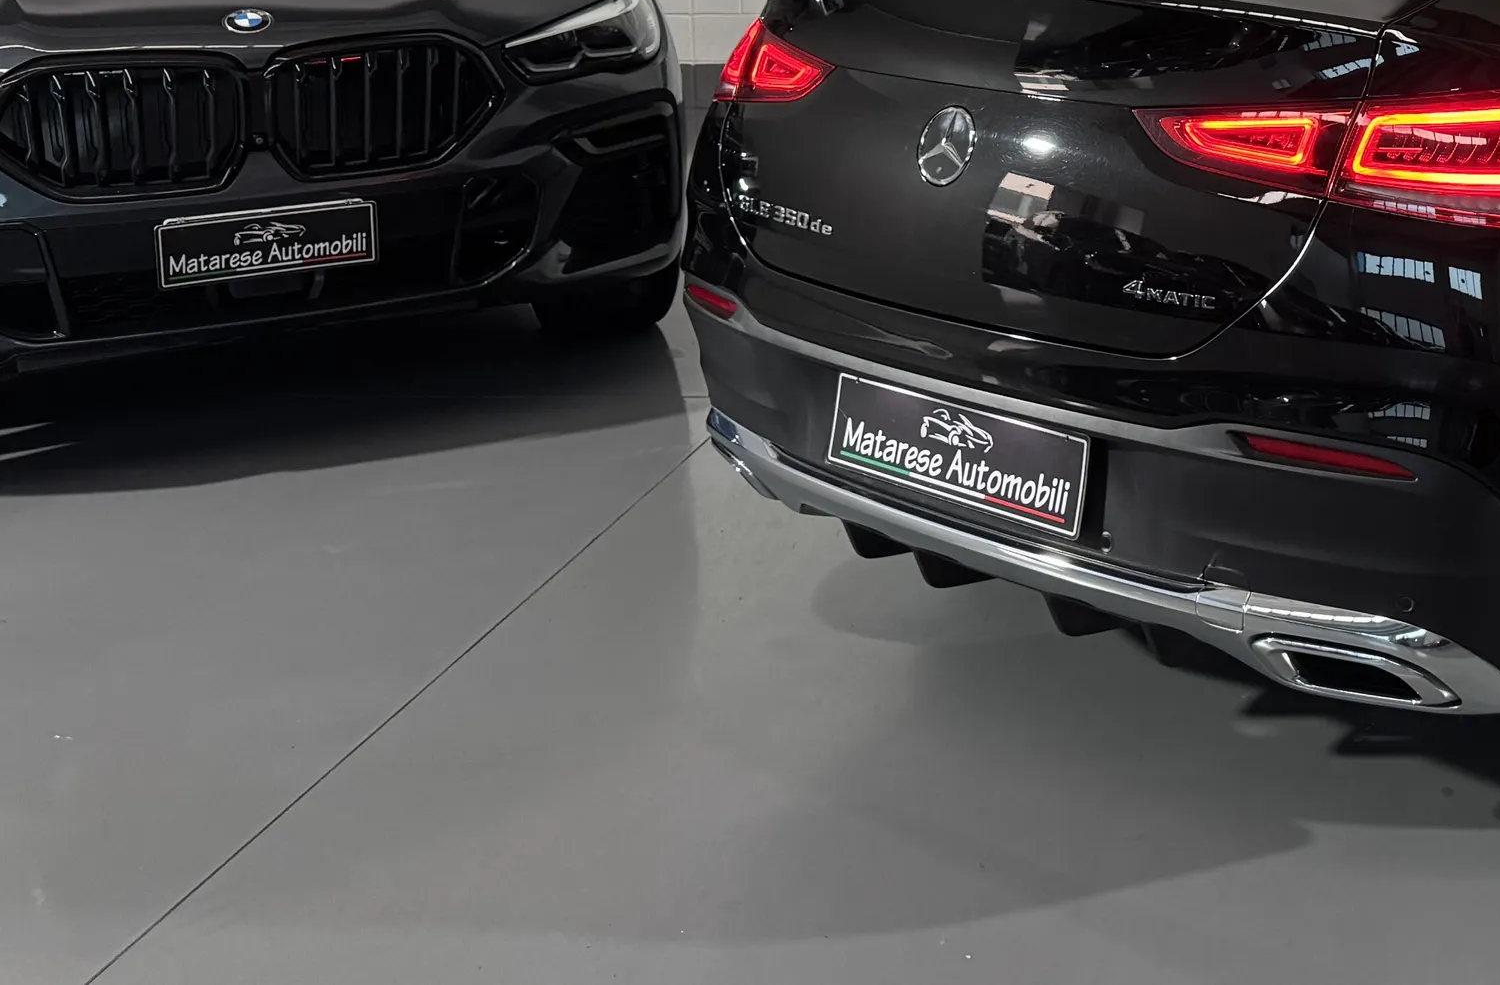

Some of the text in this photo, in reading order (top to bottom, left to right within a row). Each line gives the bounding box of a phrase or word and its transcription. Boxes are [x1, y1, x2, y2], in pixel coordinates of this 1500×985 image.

[169, 232, 367, 276] Matarese Automobili
[1123, 280, 1216, 309] 4MATIC
[843, 417, 1071, 515] Matarese Automobili
